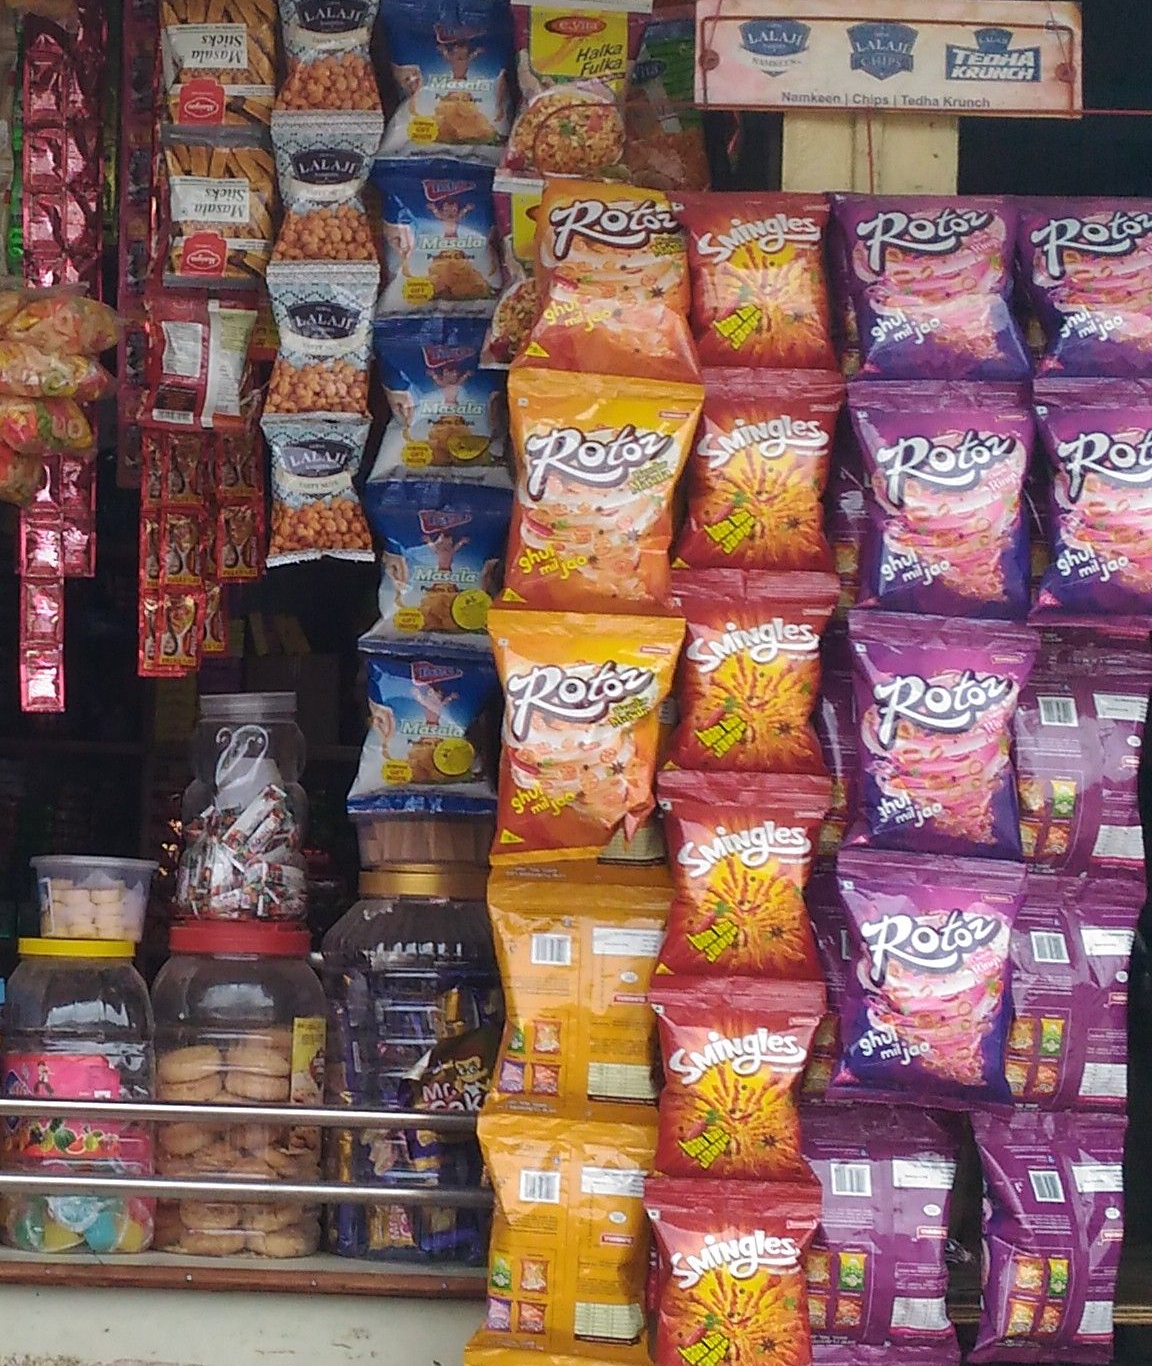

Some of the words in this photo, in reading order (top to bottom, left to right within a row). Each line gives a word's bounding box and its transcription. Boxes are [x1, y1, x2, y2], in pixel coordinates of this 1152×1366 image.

[303, 6, 362, 22] LALAJI
[748, 30, 803, 46] LALAJI
[855, 39, 913, 55] LALAJI
[576, 42, 624, 63] Halka
[952, 47, 1036, 66] TEDHA
[580, 59, 624, 77] Fulka
[951, 66, 1036, 81] KRUNCH
[430, 75, 495, 91] Masala
[781, 91, 841, 104] Namkeen
[852, 93, 889, 107] Chips
[901, 94, 939, 107] Tedha
[943, 96, 991, 109] Krunch
[298, 159, 357, 175] LALAJI
[421, 235, 485, 251] Masala
[856, 209, 991, 274] Rotoz
[294, 314, 353, 330] LALAJI
[421, 402, 484, 416] Masala
[288, 450, 348, 466] LALAJI
[526, 426, 672, 500] Rotoz
[877, 432, 1010, 508] Rotoz
[414, 567, 479, 583] Masala
[508, 661, 653, 740] Rotoz
[875, 670, 1008, 748] Rotoz
[402, 721, 465, 737] Masala
[861, 910, 997, 987] Rotoz
[858, 1030, 899, 1059] ghul
[879, 1044, 903, 1062] mil
[900, 1039, 932, 1066] jao
[422, 1082, 457, 1102] Mr.
